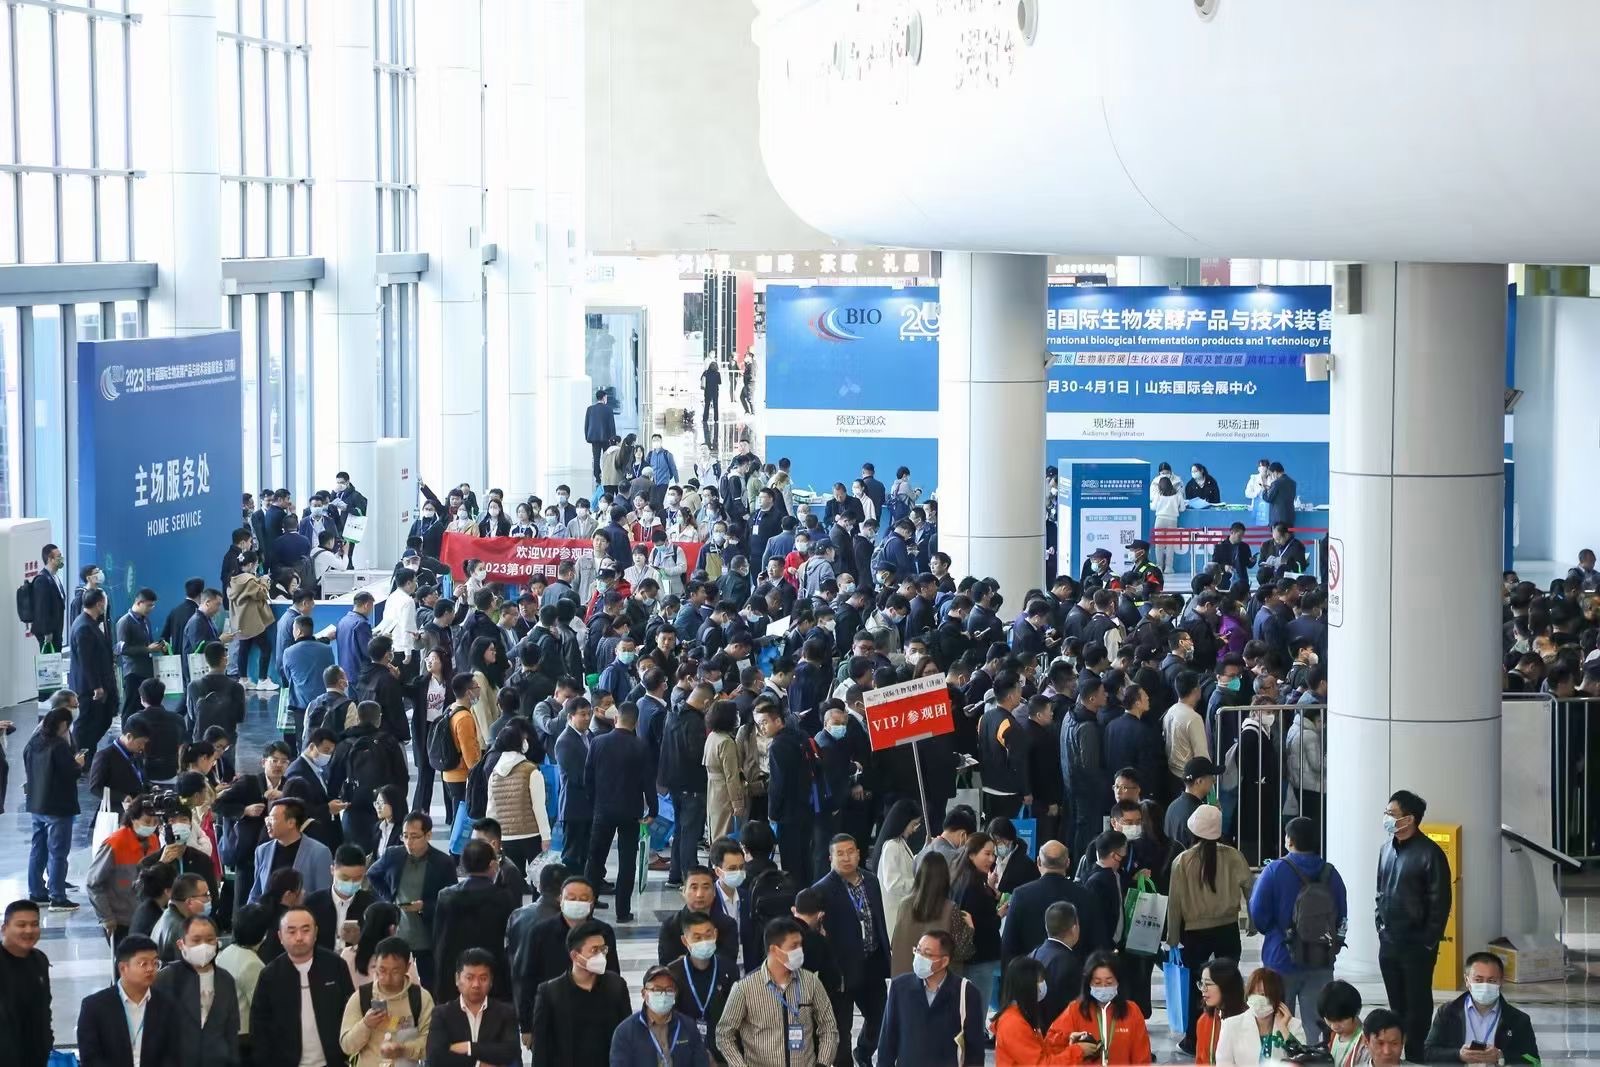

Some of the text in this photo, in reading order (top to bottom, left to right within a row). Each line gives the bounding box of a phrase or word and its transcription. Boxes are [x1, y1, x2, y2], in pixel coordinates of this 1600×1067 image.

[846, 308, 882, 325] BIO
[1091, 336, 1136, 347] biological
[1138, 336, 1199, 345] fermentation
[1202, 336, 1243, 348] products
[1246, 336, 1264, 345] and
[1266, 336, 1321, 348] Technology
[1130, 354, 1180, 365] 生化仪器展
[126, 368, 144, 393] 2023
[1145, 380, 1257, 395] 山东国际会展中心
[835, 415, 886, 426] 预登记观众
[1094, 418, 1135, 429] 现场注册
[1218, 419, 1260, 430] 现场注册
[134, 452, 210, 507] 主场服务处
[147, 510, 202, 537] HOME SERVICE
[485, 562, 562, 578] 023第10届国
[872, 702, 948, 732] VIP/参观团
